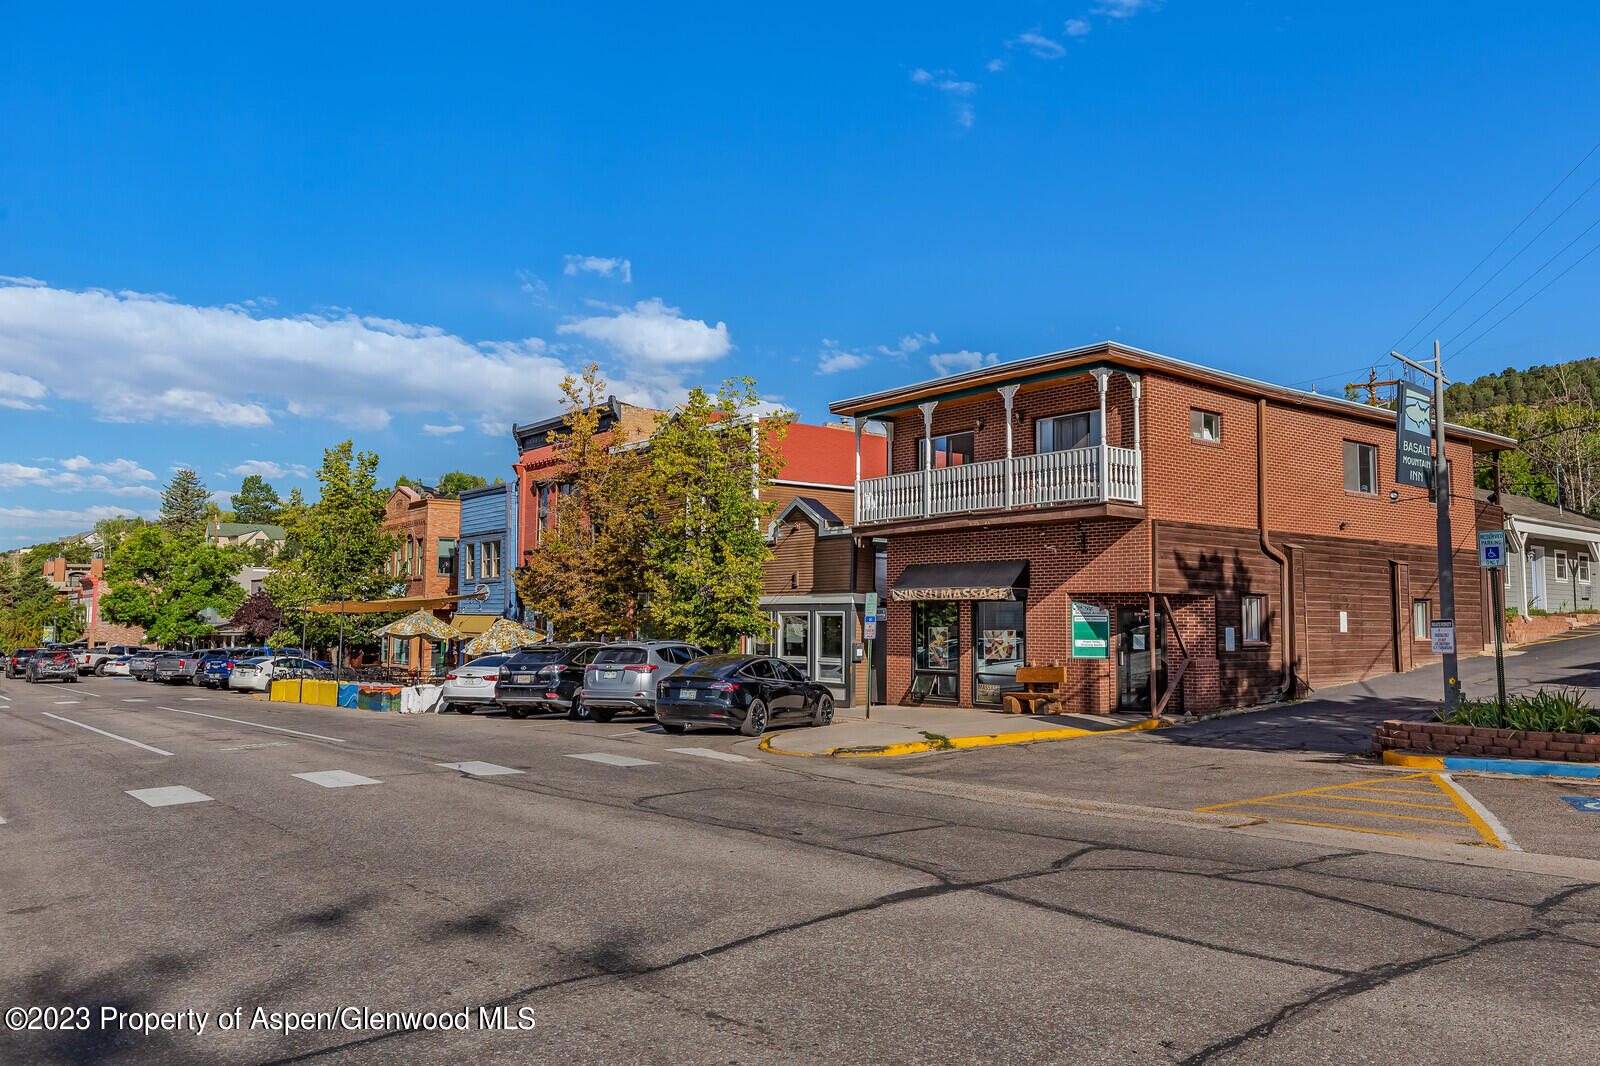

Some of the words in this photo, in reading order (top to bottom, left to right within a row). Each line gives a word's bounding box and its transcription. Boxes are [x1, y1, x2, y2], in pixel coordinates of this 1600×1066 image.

[1403, 440, 1431, 456] BASALT
[1402, 455, 1431, 469] MOUNTAIN
[1409, 470, 1424, 482] INN
[940, 587, 1007, 601] MASSAGE
